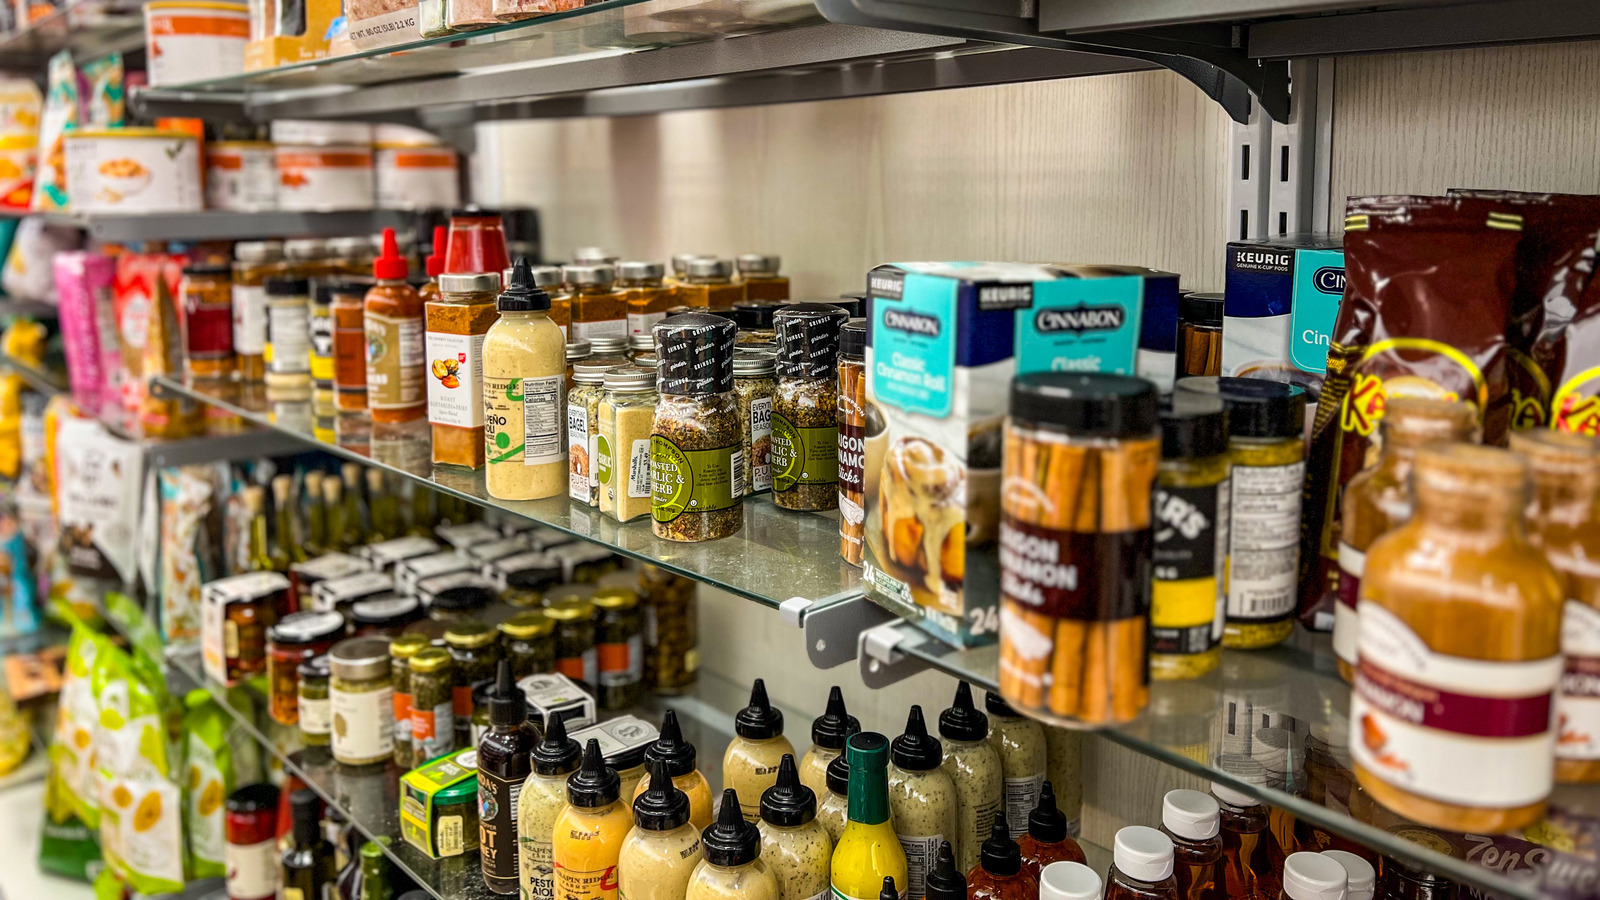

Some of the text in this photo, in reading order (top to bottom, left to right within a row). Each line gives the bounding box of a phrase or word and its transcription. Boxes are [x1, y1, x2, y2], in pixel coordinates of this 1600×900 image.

[356, 31, 367, 39] WT.
[373, 26, 382, 34] OZ
[395, 20, 405, 29] 2.2
[404, 18, 415, 27] KG
[1237, 252, 1289, 265] KEURIG
[871, 278, 903, 292] KEURIG
[980, 286, 1031, 303] KEURIG
[808, 315, 831, 327] GRINDER
[885, 310, 938, 335] CINNABON
[1037, 309, 1120, 331] CINNABON
[692, 324, 716, 336] GRINDER
[810, 333, 829, 344] grinder
[1302, 329, 1330, 346] Cin
[694, 342, 715, 355] grinder
[809, 347, 830, 358] GRINDER
[693, 358, 715, 370] GRINDER
[891, 352, 926, 373] Classic
[810, 364, 829, 376] grinder
[877, 361, 921, 384] Cinnamon
[923, 373, 946, 392] Roll
[569, 416, 586, 432] BAGEL
[753, 410, 771, 424] BAG
[789, 449, 798, 458] &
[630, 455, 639, 482] Marshalls
[676, 475, 685, 484] &
[863, 560, 875, 586] 24
[969, 605, 998, 636] 24
[583, 873, 614, 884] RIDGE
